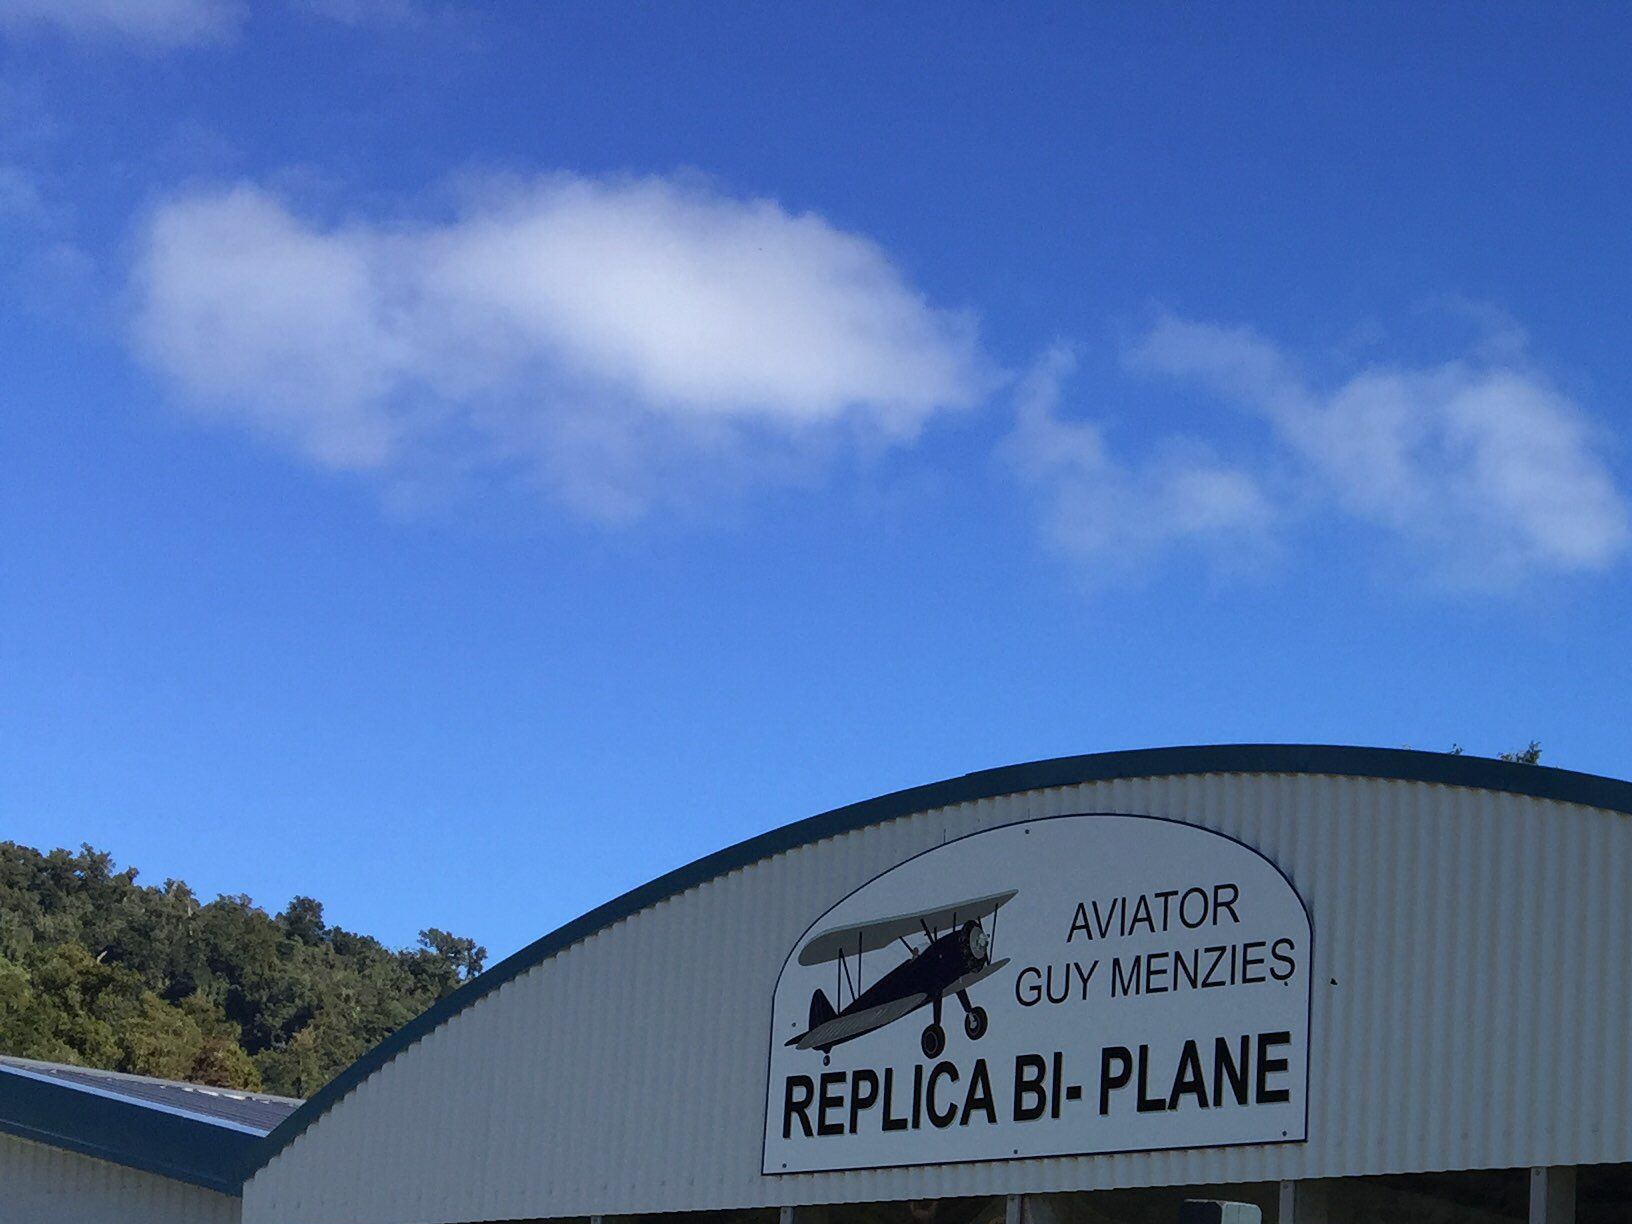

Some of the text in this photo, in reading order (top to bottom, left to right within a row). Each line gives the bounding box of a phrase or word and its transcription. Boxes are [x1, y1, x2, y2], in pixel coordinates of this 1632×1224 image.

[1066, 883, 1241, 944] AVIATOR
[1015, 937, 1296, 1007] GUY MENZIES
[782, 1030, 1293, 1141] REPLICA BI- PLANE
